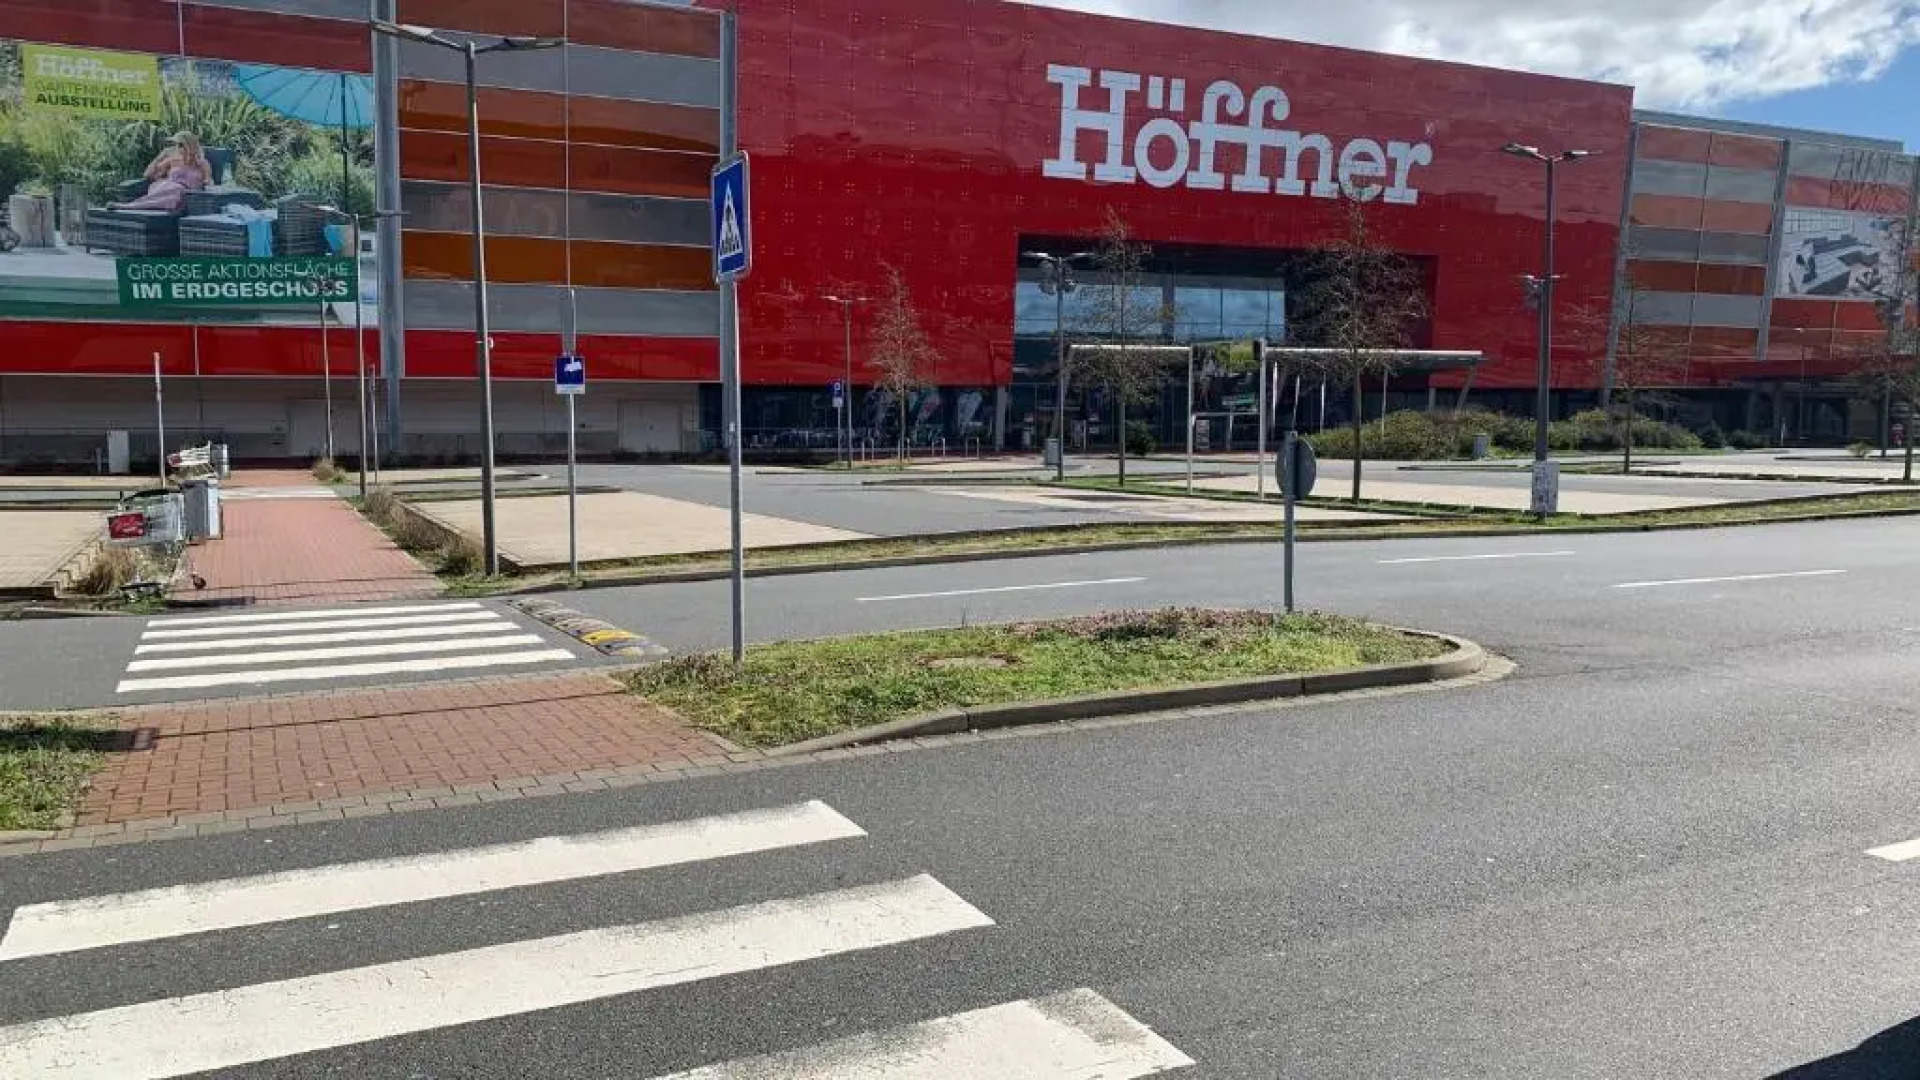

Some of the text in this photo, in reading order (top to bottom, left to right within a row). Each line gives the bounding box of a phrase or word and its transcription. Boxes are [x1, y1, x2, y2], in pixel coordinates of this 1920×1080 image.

[35, 93, 151, 113] AUSSTELLUNG
[1042, 64, 1433, 204] Höffner
[127, 260, 350, 280] GROSSE AKTIONSFLÄCHE
[132, 283, 162, 299] IM
